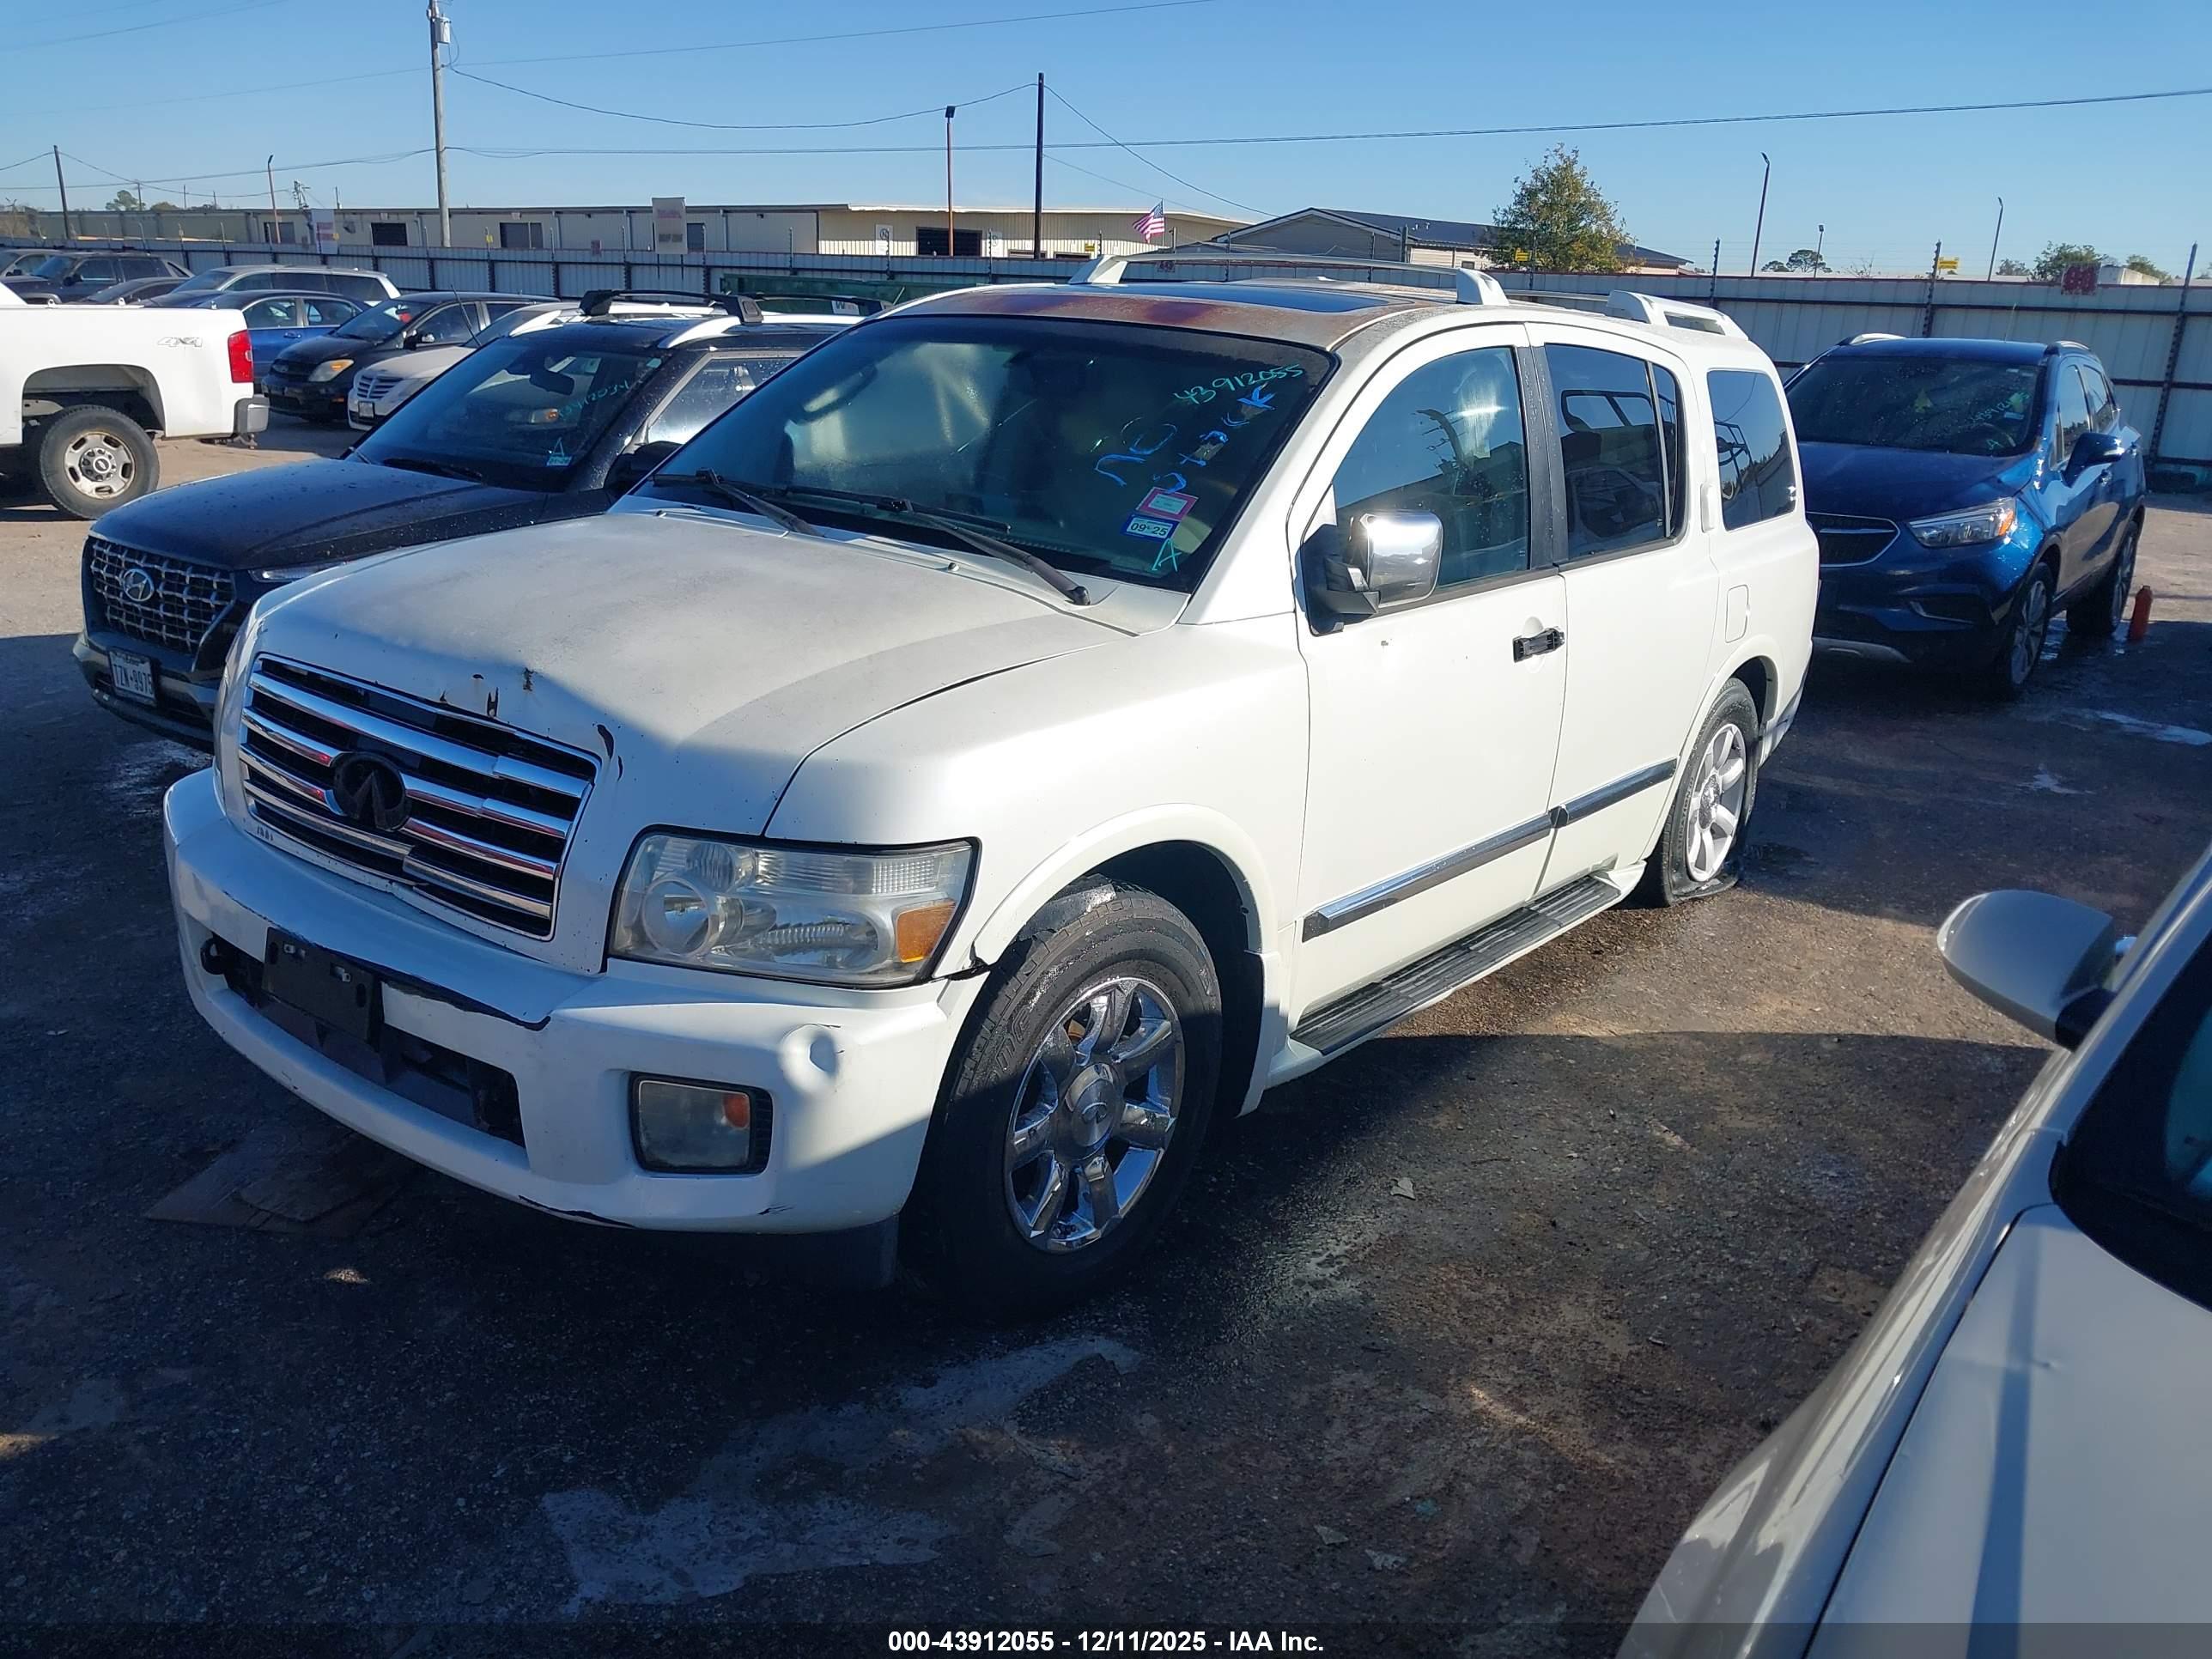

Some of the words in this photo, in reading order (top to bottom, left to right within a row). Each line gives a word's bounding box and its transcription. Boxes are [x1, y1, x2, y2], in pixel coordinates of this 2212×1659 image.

[1174, 363, 1304, 404] 43912055
[1130, 522, 1146, 532] 09
[1152, 526, 1168, 536] 25
[1152, 538, 1182, 571] A
